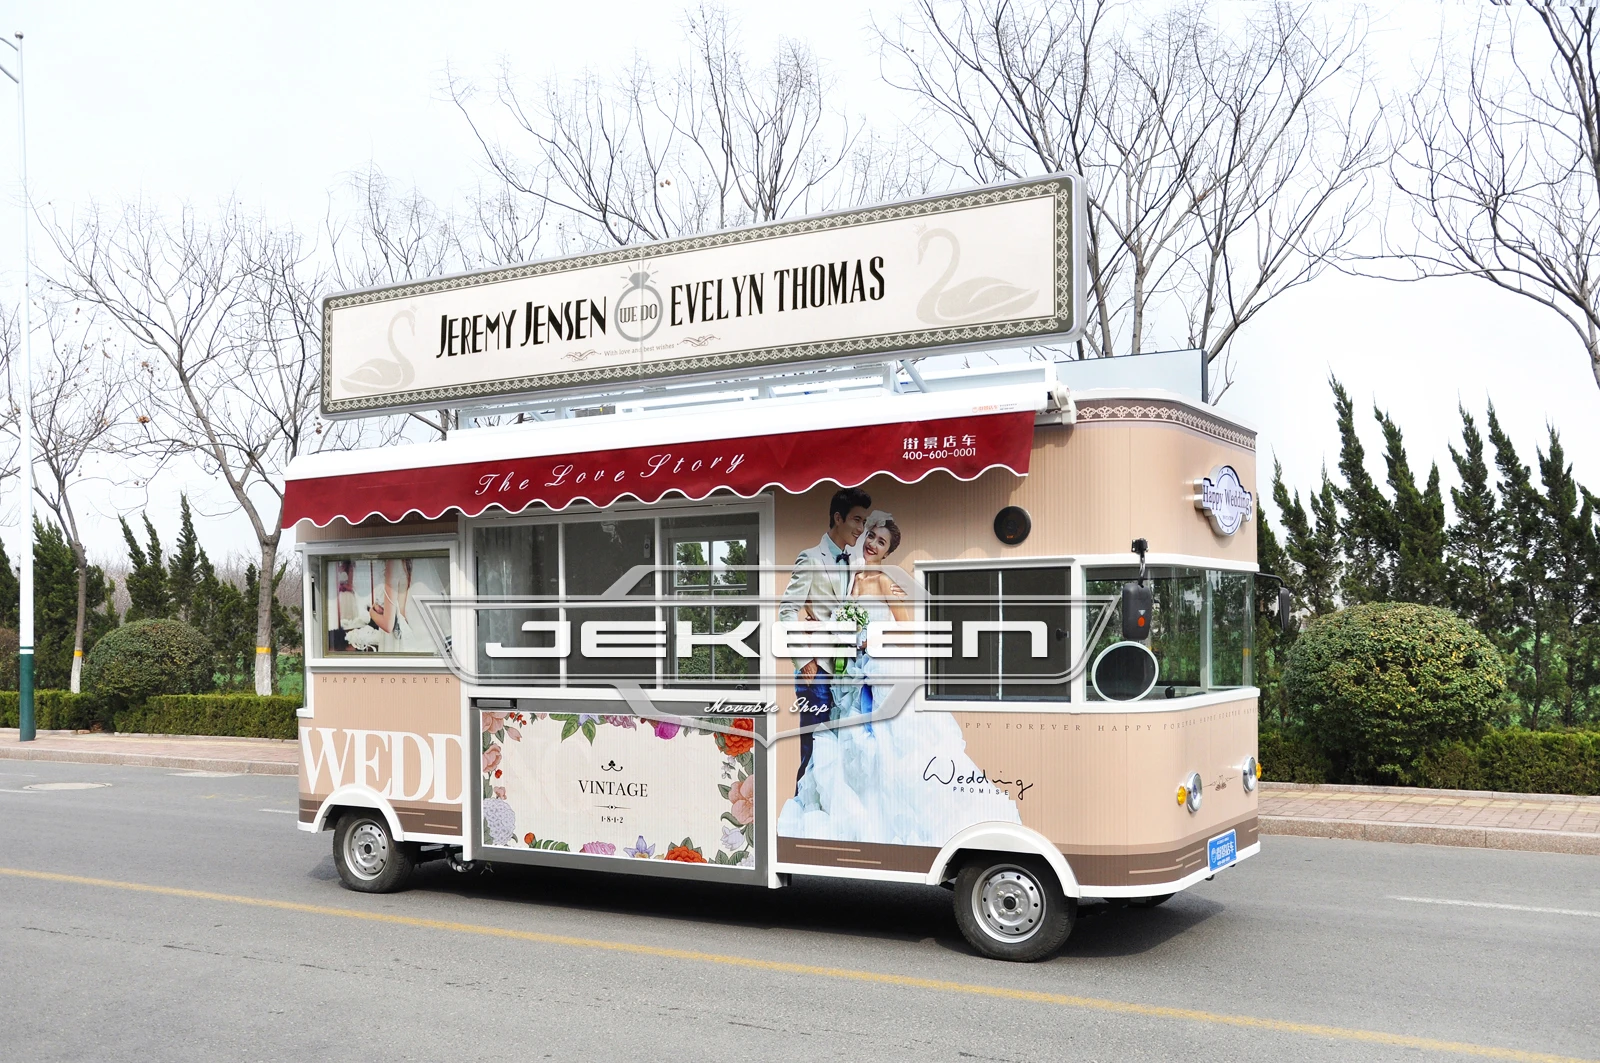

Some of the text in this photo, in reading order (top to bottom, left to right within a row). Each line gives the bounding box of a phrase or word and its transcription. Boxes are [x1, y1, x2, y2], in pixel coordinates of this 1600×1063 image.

[670, 255, 885, 327] EVELYN THOMAS
[619, 303, 658, 324] WE DO
[435, 295, 607, 359] JEREMY JENSEN
[643, 344, 655, 352] best
[656, 343, 675, 351] wishes
[903, 434, 976, 450] 街景店车
[902, 447, 976, 460] 400-600-0001
[475, 453, 745, 496] The Love Story
[1203, 485, 1250, 516] Happy Wedding
[1005, 723, 1081, 731] FOREVER
[1098, 724, 1152, 732] HAPPY
[578, 779, 649, 797] VINTAGE
[923, 756, 1034, 801] Wedding
[953, 786, 1009, 795] PROMISE
